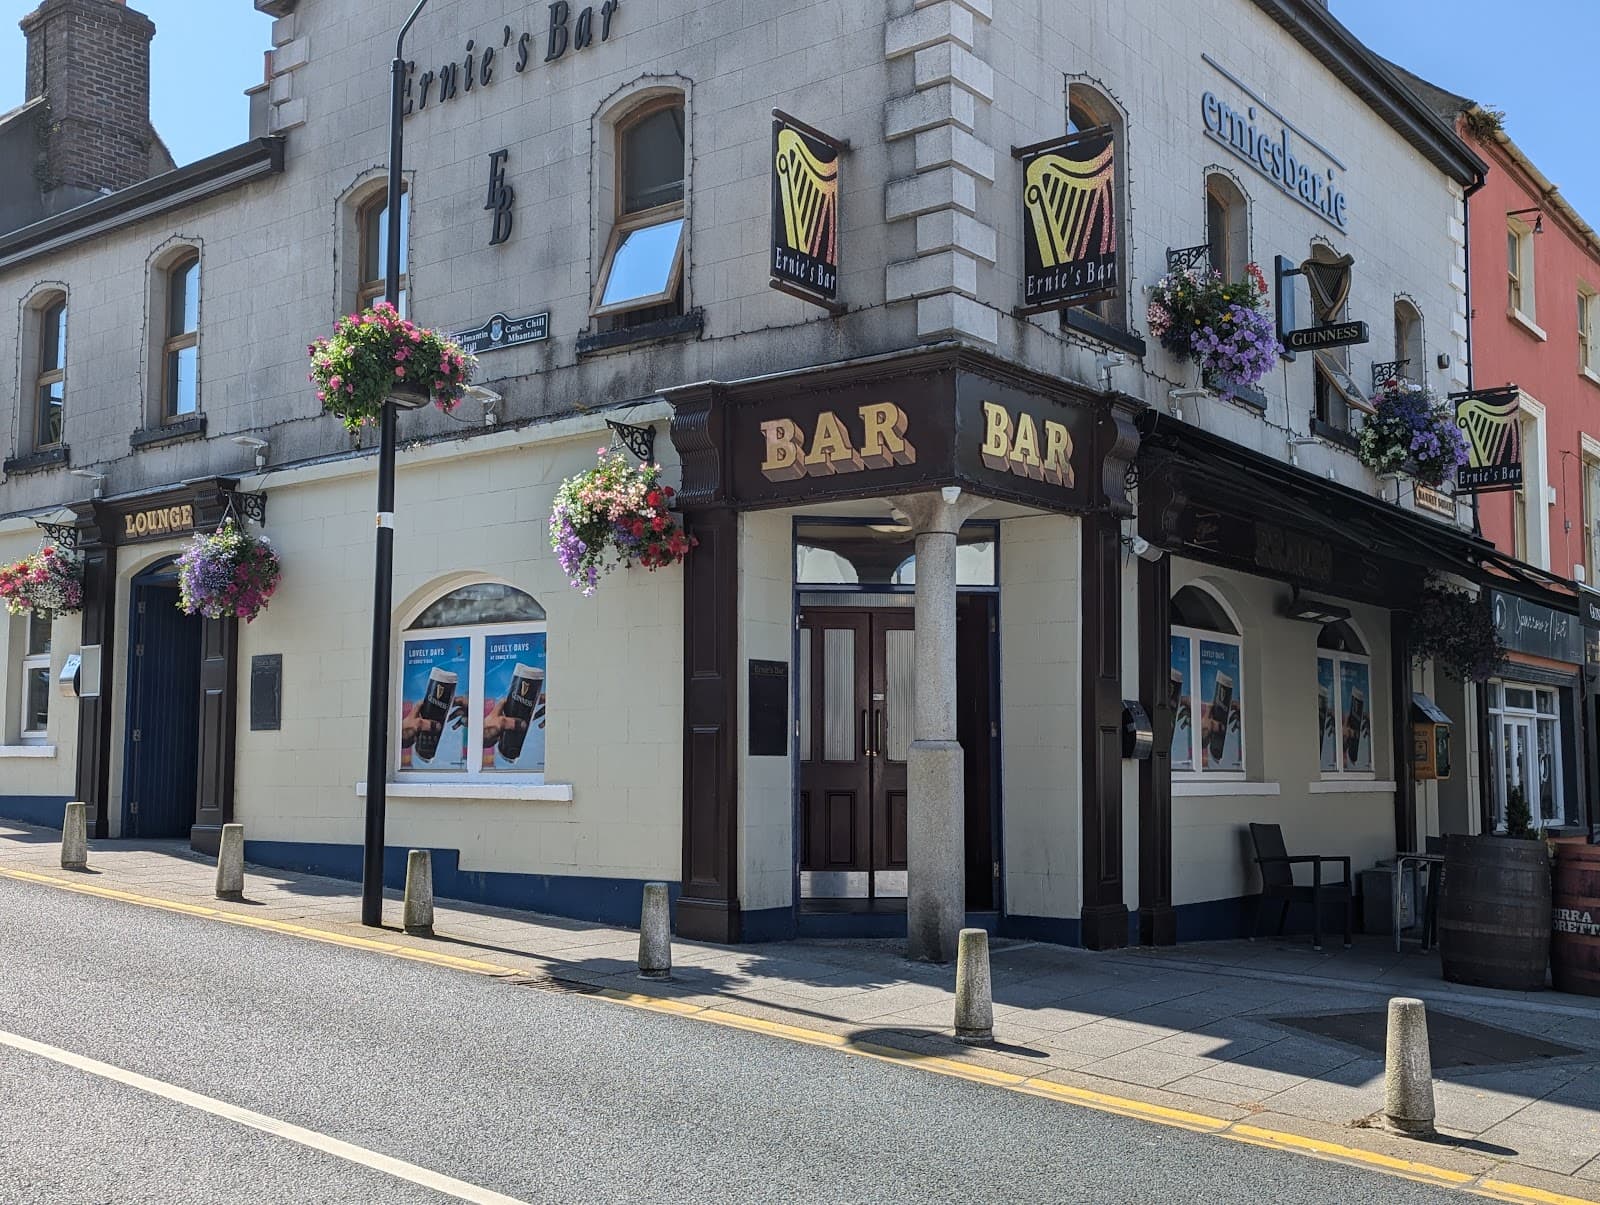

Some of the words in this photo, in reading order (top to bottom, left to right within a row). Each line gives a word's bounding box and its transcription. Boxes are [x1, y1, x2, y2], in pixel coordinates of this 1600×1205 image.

[402, 25, 530, 115] Ernie's
[544, 0, 618, 63] Bar
[1202, 91, 1348, 227] erniesbar.ie
[775, 246, 815, 282] Ernie's
[817, 264, 836, 290] Bar
[1027, 265, 1081, 297] Ernie's
[1087, 261, 1114, 284] Bar
[525, 317, 545, 330] Chill
[1291, 325, 1359, 346] GUINNESS
[760, 401, 917, 483] BAR
[981, 400, 1075, 489] BAR
[1459, 468, 1498, 484] Ernie's
[1501, 466, 1521, 480] Bar
[125, 505, 194, 539] LOUNGE
[408, 648, 429, 658] LOVELY
[430, 647, 445, 657] DAYS
[490, 644, 512, 653] LOVELY
[513, 642, 530, 652] DAYS
